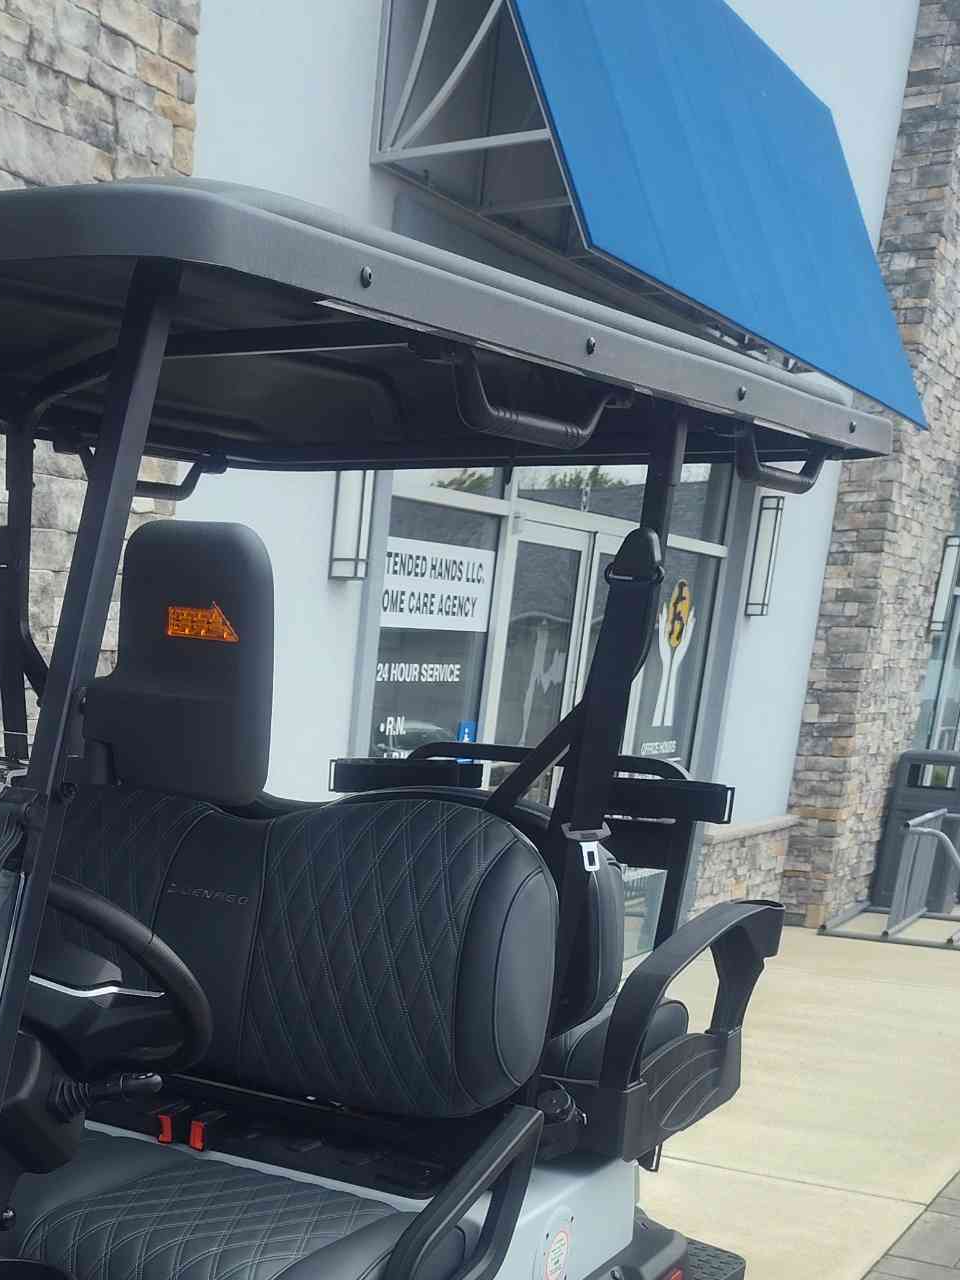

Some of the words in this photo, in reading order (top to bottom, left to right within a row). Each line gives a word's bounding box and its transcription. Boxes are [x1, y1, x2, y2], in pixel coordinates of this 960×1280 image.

[386, 552, 427, 577] TENDED
[430, 557, 463, 582] HANDS
[382, 589, 405, 613] OME
[408, 591, 436, 615] CARE
[437, 594, 478, 618] AGENCY
[376, 663, 389, 681] 24
[390, 663, 419, 681] HOUR
[420, 663, 461, 682] SERVICE
